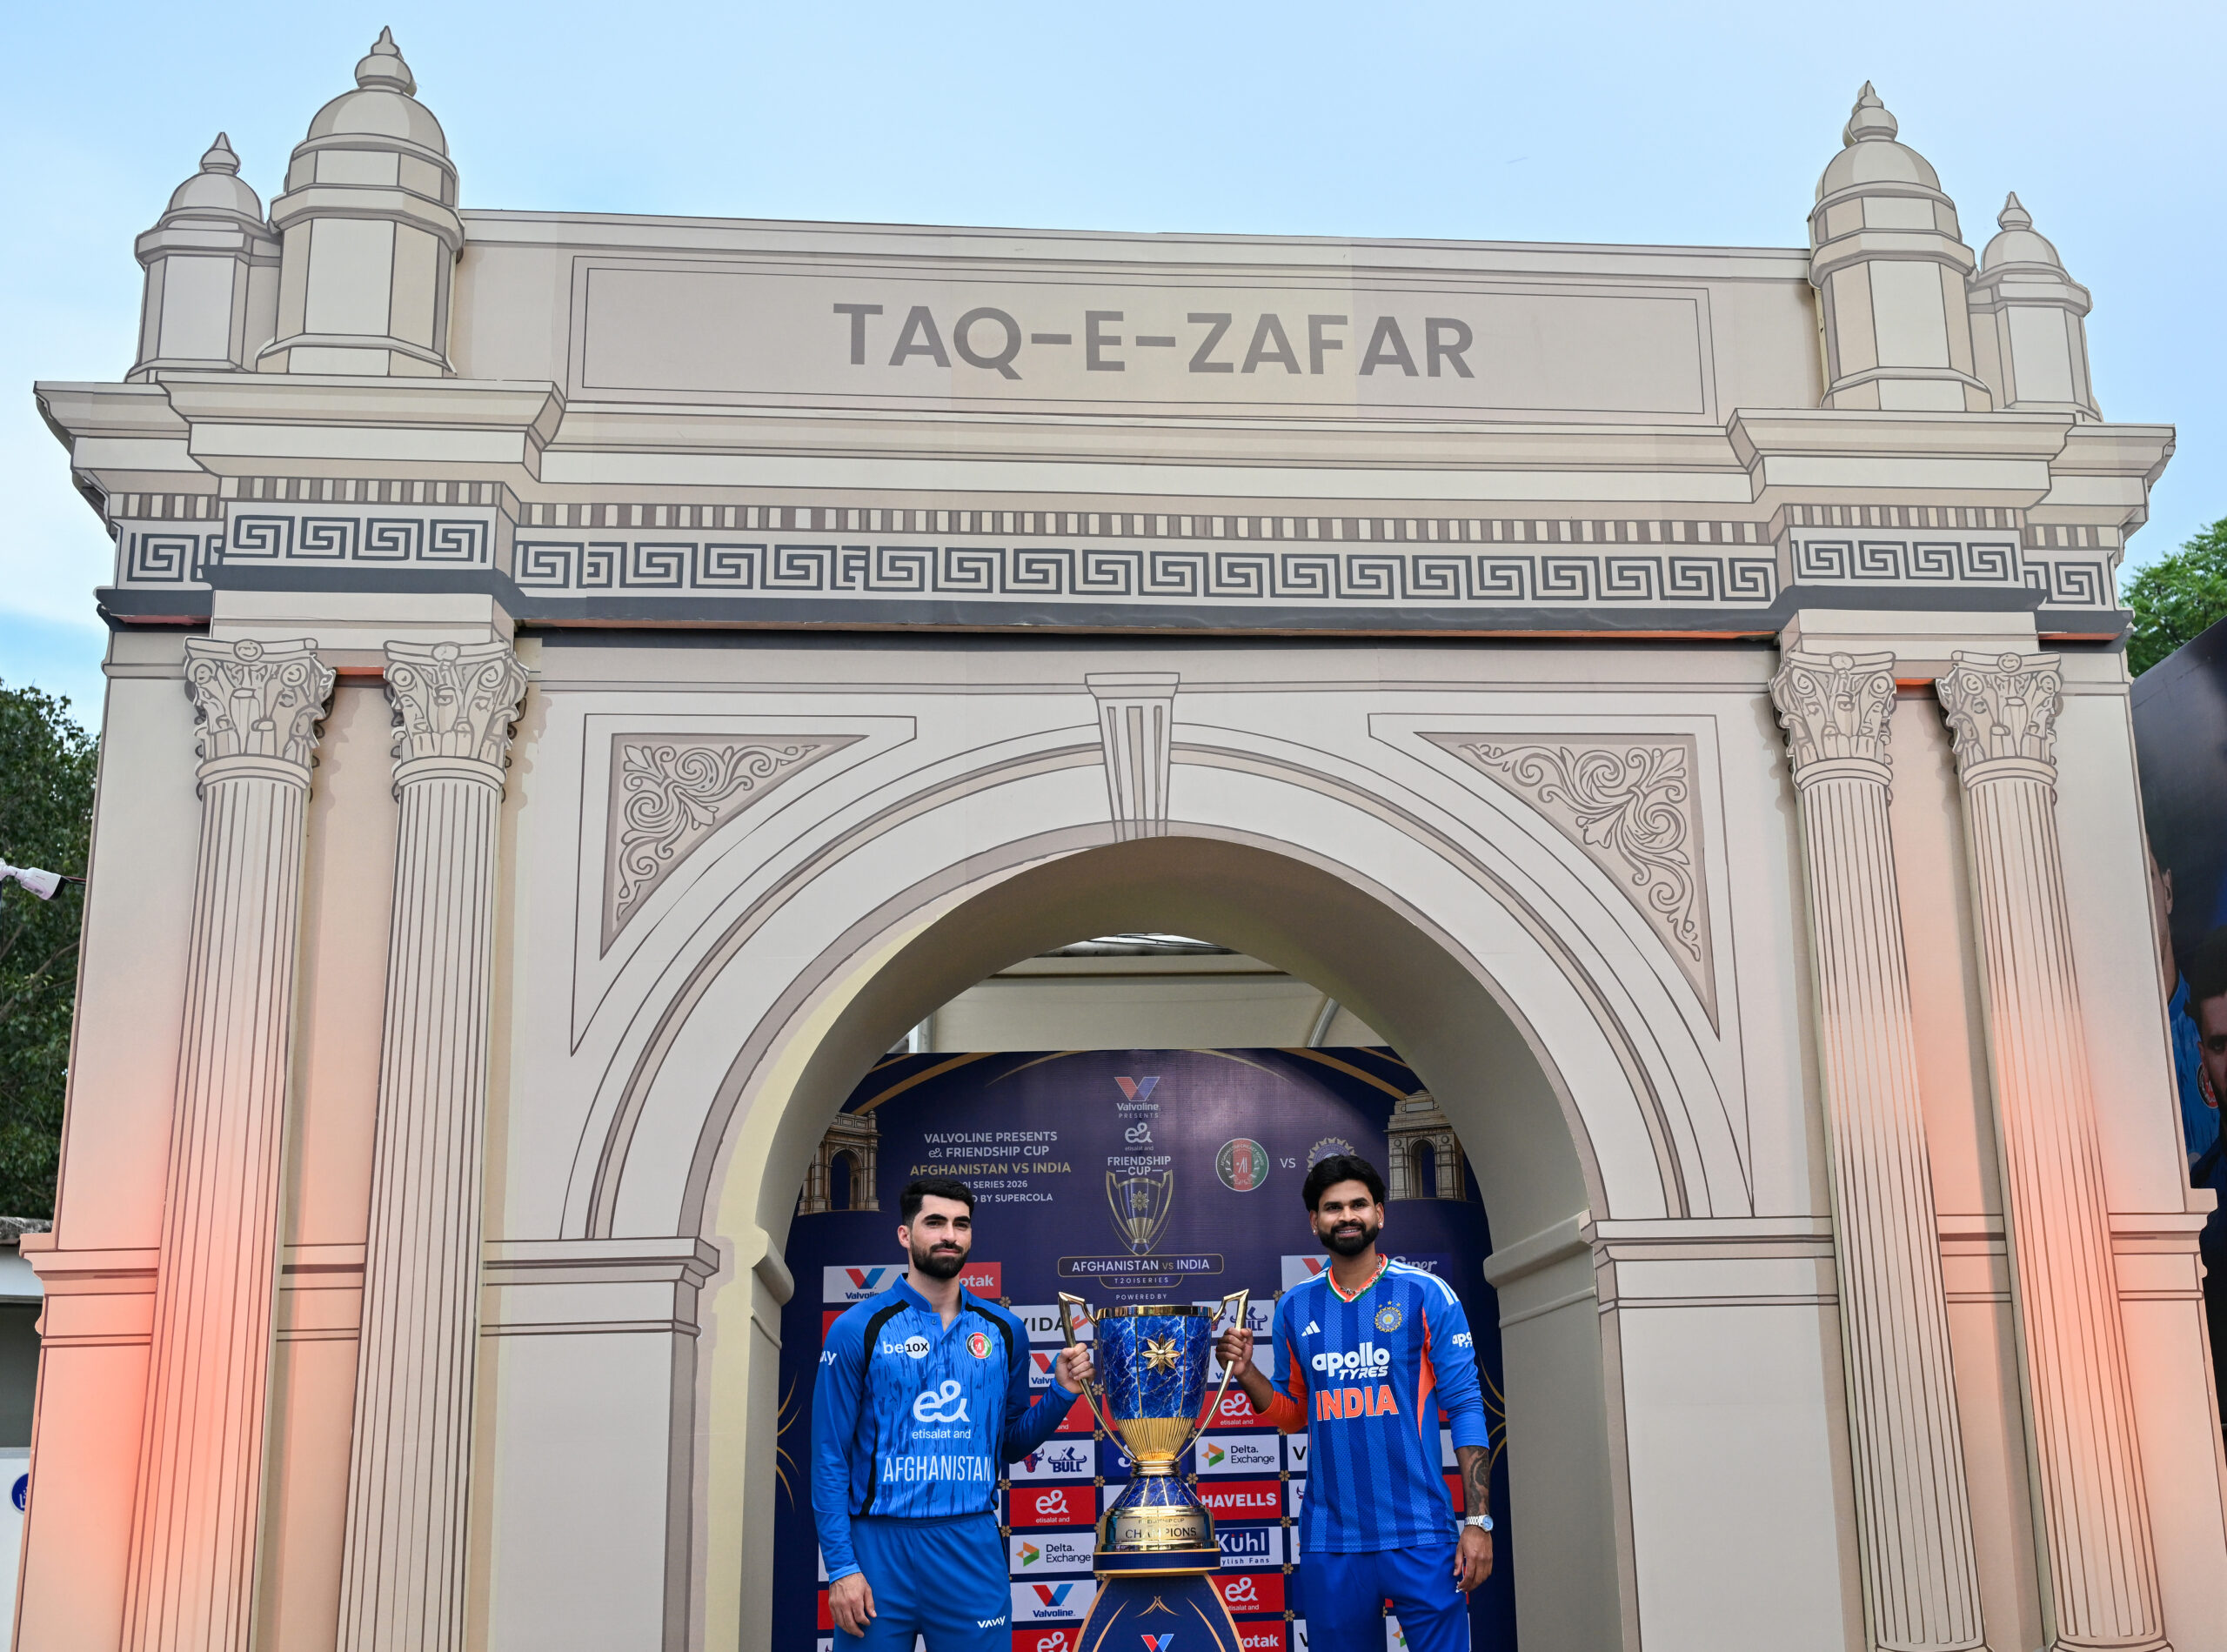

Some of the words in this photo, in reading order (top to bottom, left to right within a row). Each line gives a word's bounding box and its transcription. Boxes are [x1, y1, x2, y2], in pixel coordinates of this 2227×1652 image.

[833, 303, 1475, 380] TAQ-E-ZAFAR
[1116, 1102, 1160, 1111] Valvoline
[924, 1132, 993, 1144] VALVOLINE
[996, 1131, 1058, 1142] PRESENTS
[946, 1146, 1020, 1158] FRIENDSHIP
[1023, 1145, 1050, 1156] CUP
[1107, 1155, 1171, 1166] FRIENDSHIP
[1280, 1158, 1296, 1168] VS
[910, 1163, 1008, 1176] AFGHANISTAN
[1012, 1162, 1029, 1174] VS
[1033, 1161, 1072, 1173] INDIA
[1127, 1166, 1151, 1175] CUP
[973, 1180, 1005, 1189] SERIES
[1006, 1180, 1028, 1188] 2026
[980, 1194, 992, 1203] BY
[995, 1193, 1053, 1203] SUPERCOLA
[1072, 1260, 1159, 1272] AFGHANISTAN
[1176, 1259, 1210, 1270] INDIA
[960, 1274, 993, 1287] otak
[1312, 1341, 1390, 1377] apollo
[1339, 1365, 1388, 1381] TYRES
[1314, 1384, 1400, 1421] INDIA
[912, 1429, 951, 1439] etisalat
[953, 1429, 971, 1439] and
[1230, 1445, 1259, 1454] Delta.
[1231, 1455, 1275, 1465] Exchange
[883, 1455, 992, 1482] AFGHANISTAN
[1053, 1461, 1082, 1473] BULL
[1201, 1493, 1277, 1508] HAVELLS
[1046, 1543, 1075, 1553] Delta.
[1215, 1532, 1266, 1553] Kühl
[1046, 1553, 1091, 1563] Exchange
[1242, 1634, 1279, 1648] otak
